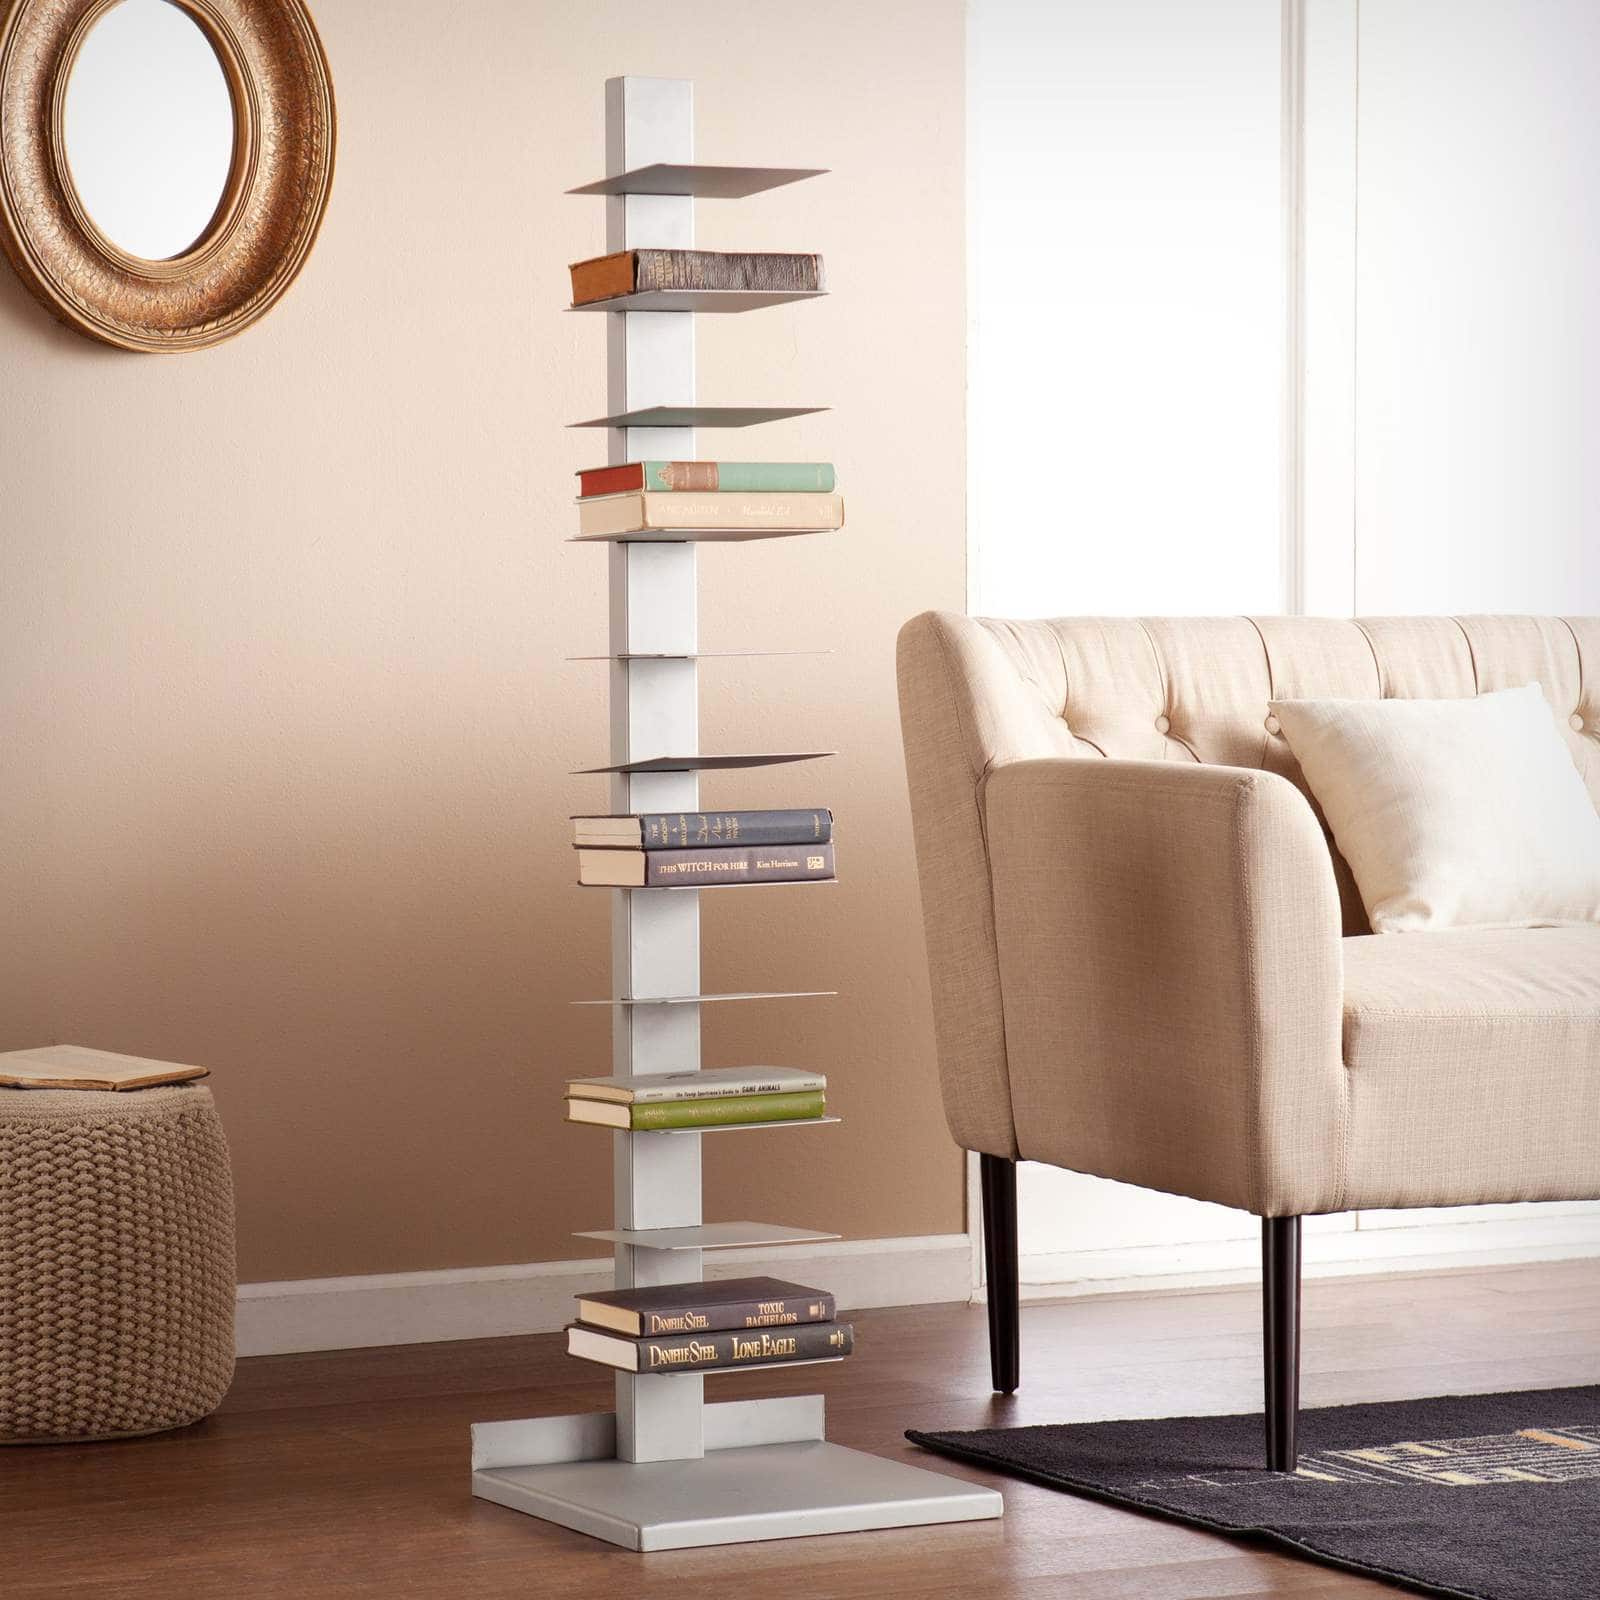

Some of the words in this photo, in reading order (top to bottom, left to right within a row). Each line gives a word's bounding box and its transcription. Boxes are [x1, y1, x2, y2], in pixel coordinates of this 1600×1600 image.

[659, 865, 677, 874] THIS
[678, 861, 712, 873] WITCH
[713, 863, 728, 871] FOR
[756, 860, 770, 869] Kim
[771, 859, 799, 868] Harrison
[742, 1084, 756, 1093] GAME
[758, 1083, 781, 1092] ANIMALS
[758, 1301, 785, 1314] TOXIC
[651, 1315, 687, 1333] DANIELLE
[684, 1311, 709, 1331] STEEL
[746, 1313, 797, 1328] BACHELORS
[649, 1345, 690, 1366] DANIELLE
[689, 1341, 719, 1363] STEEL
[731, 1337, 761, 1360] LONE
[761, 1334, 797, 1357] EAGLE
